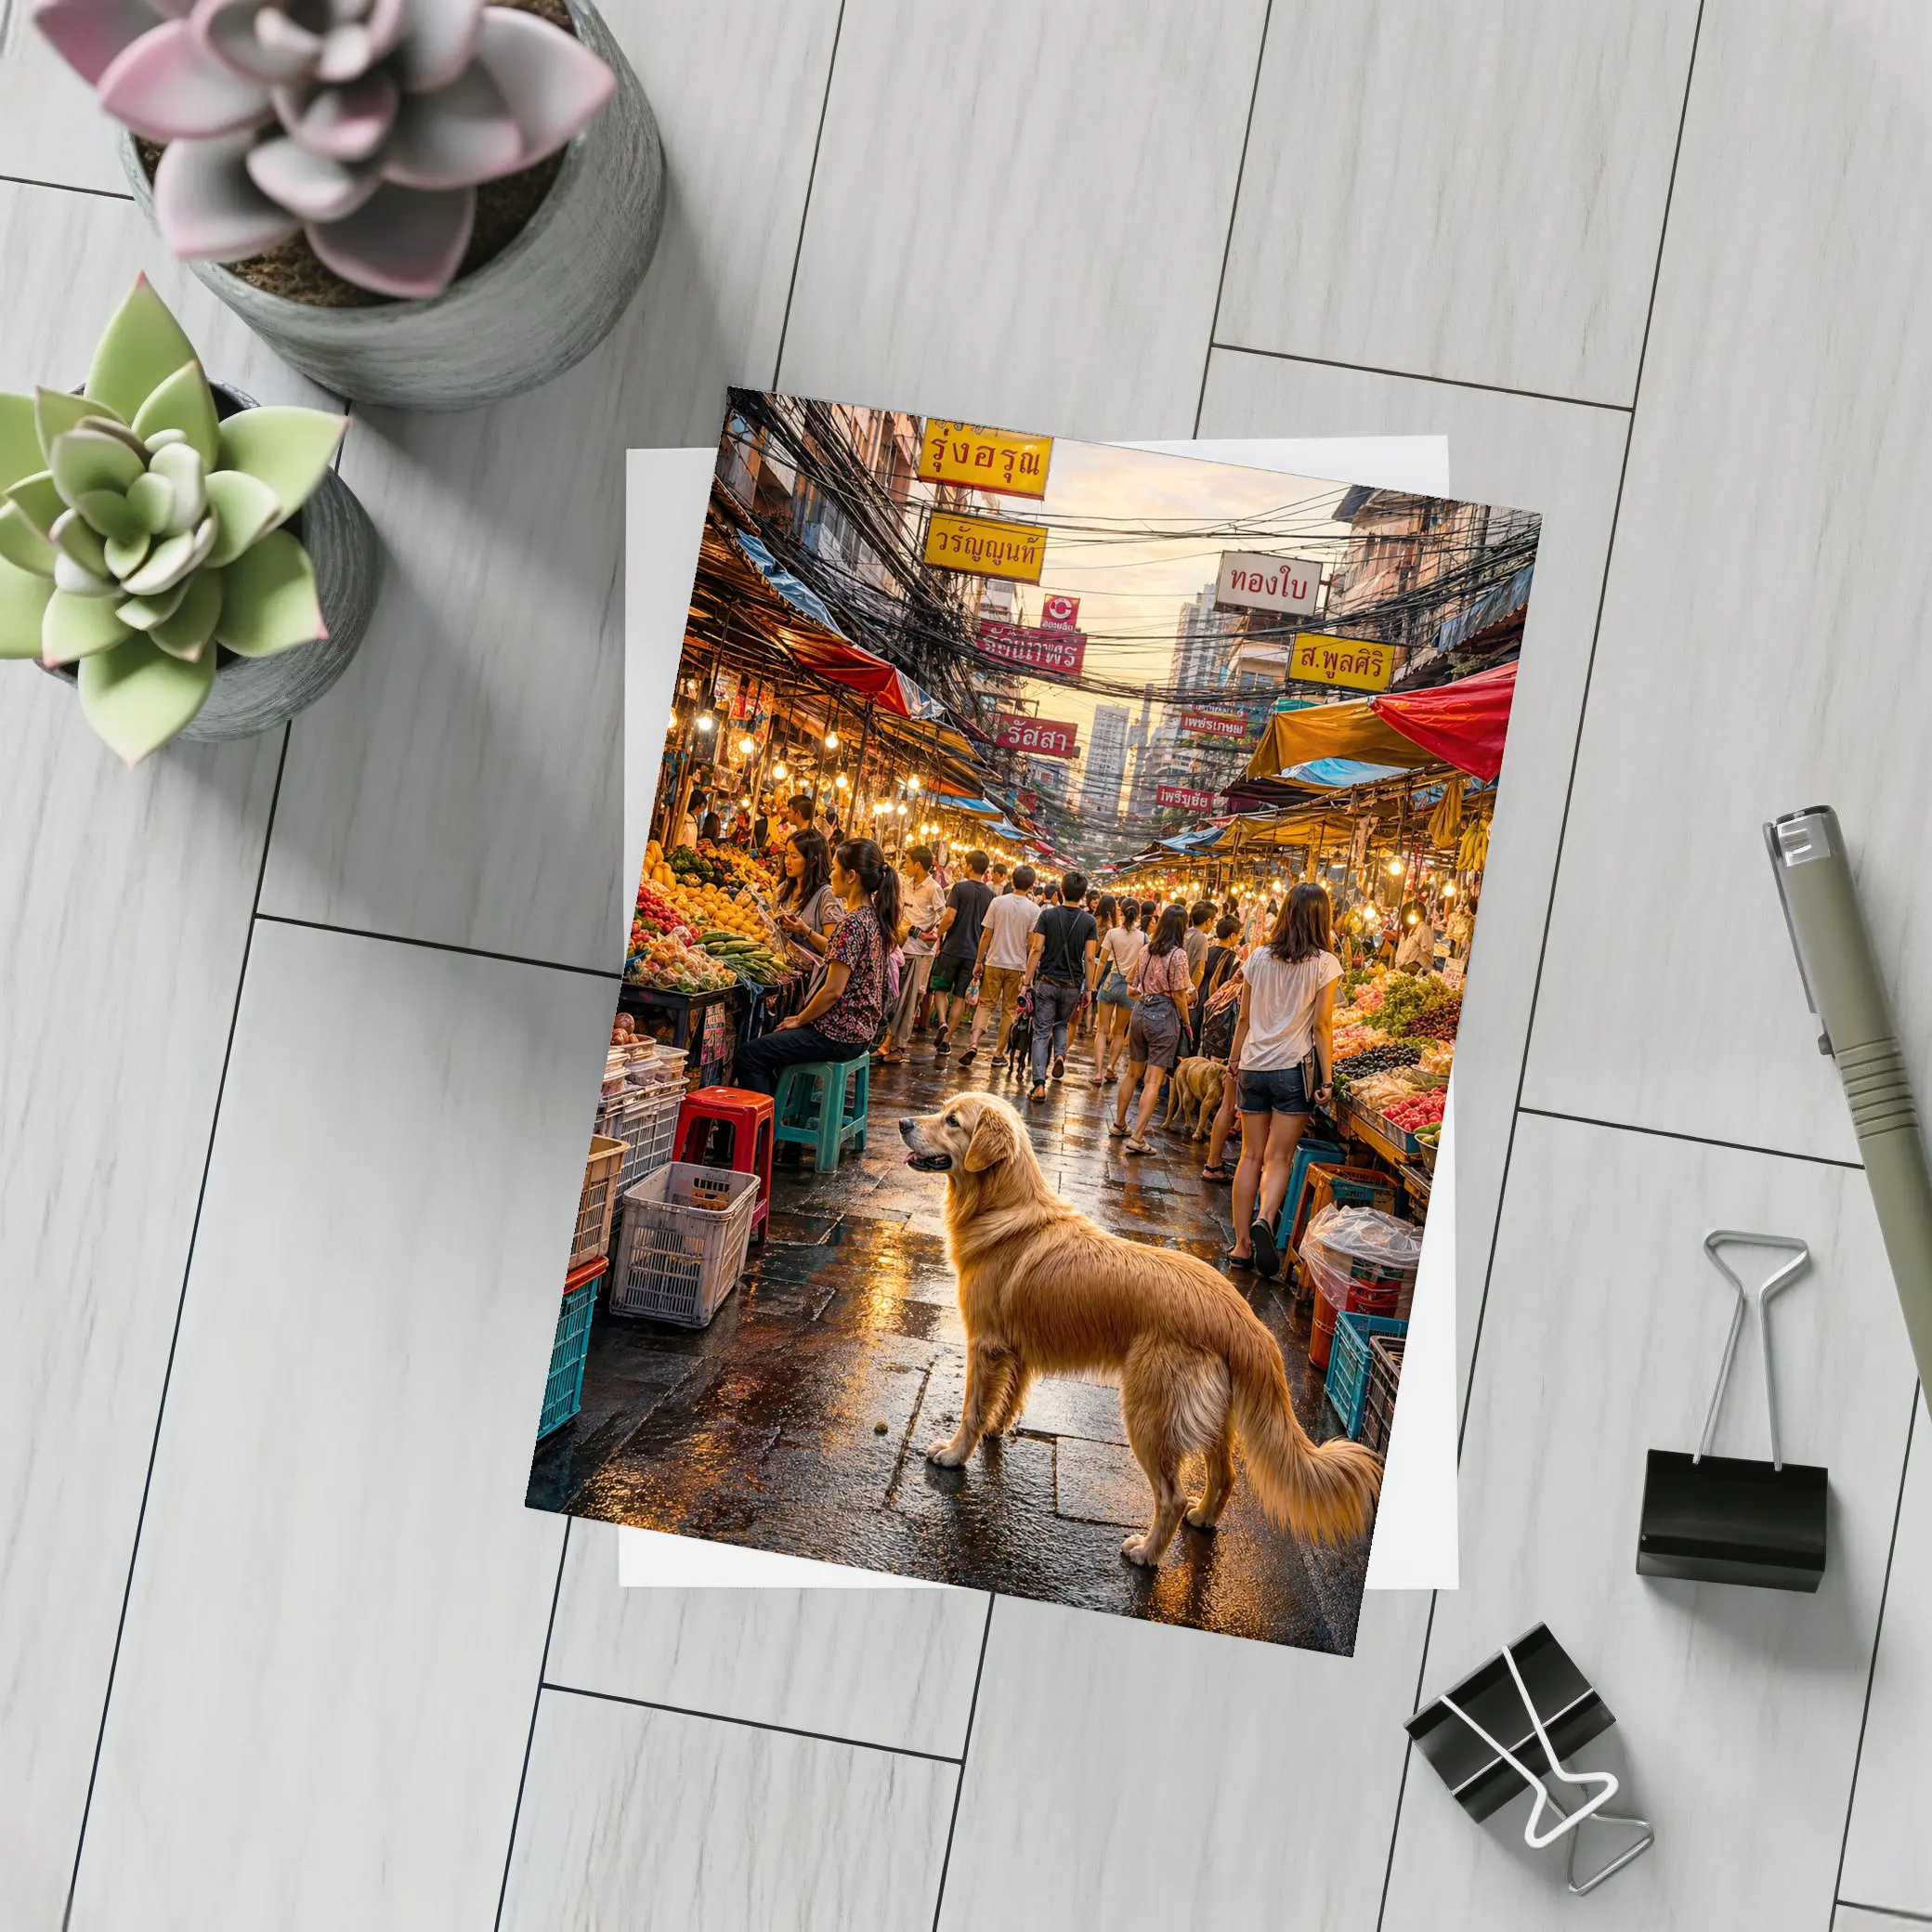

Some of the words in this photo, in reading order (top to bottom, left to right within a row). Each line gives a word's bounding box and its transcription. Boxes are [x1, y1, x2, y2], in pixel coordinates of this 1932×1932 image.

[931, 428, 1040, 483] รุ่งอรุณ
[1231, 564, 1308, 600] ทองใบ
[1301, 646, 1385, 679] ส.พูลศิริ
